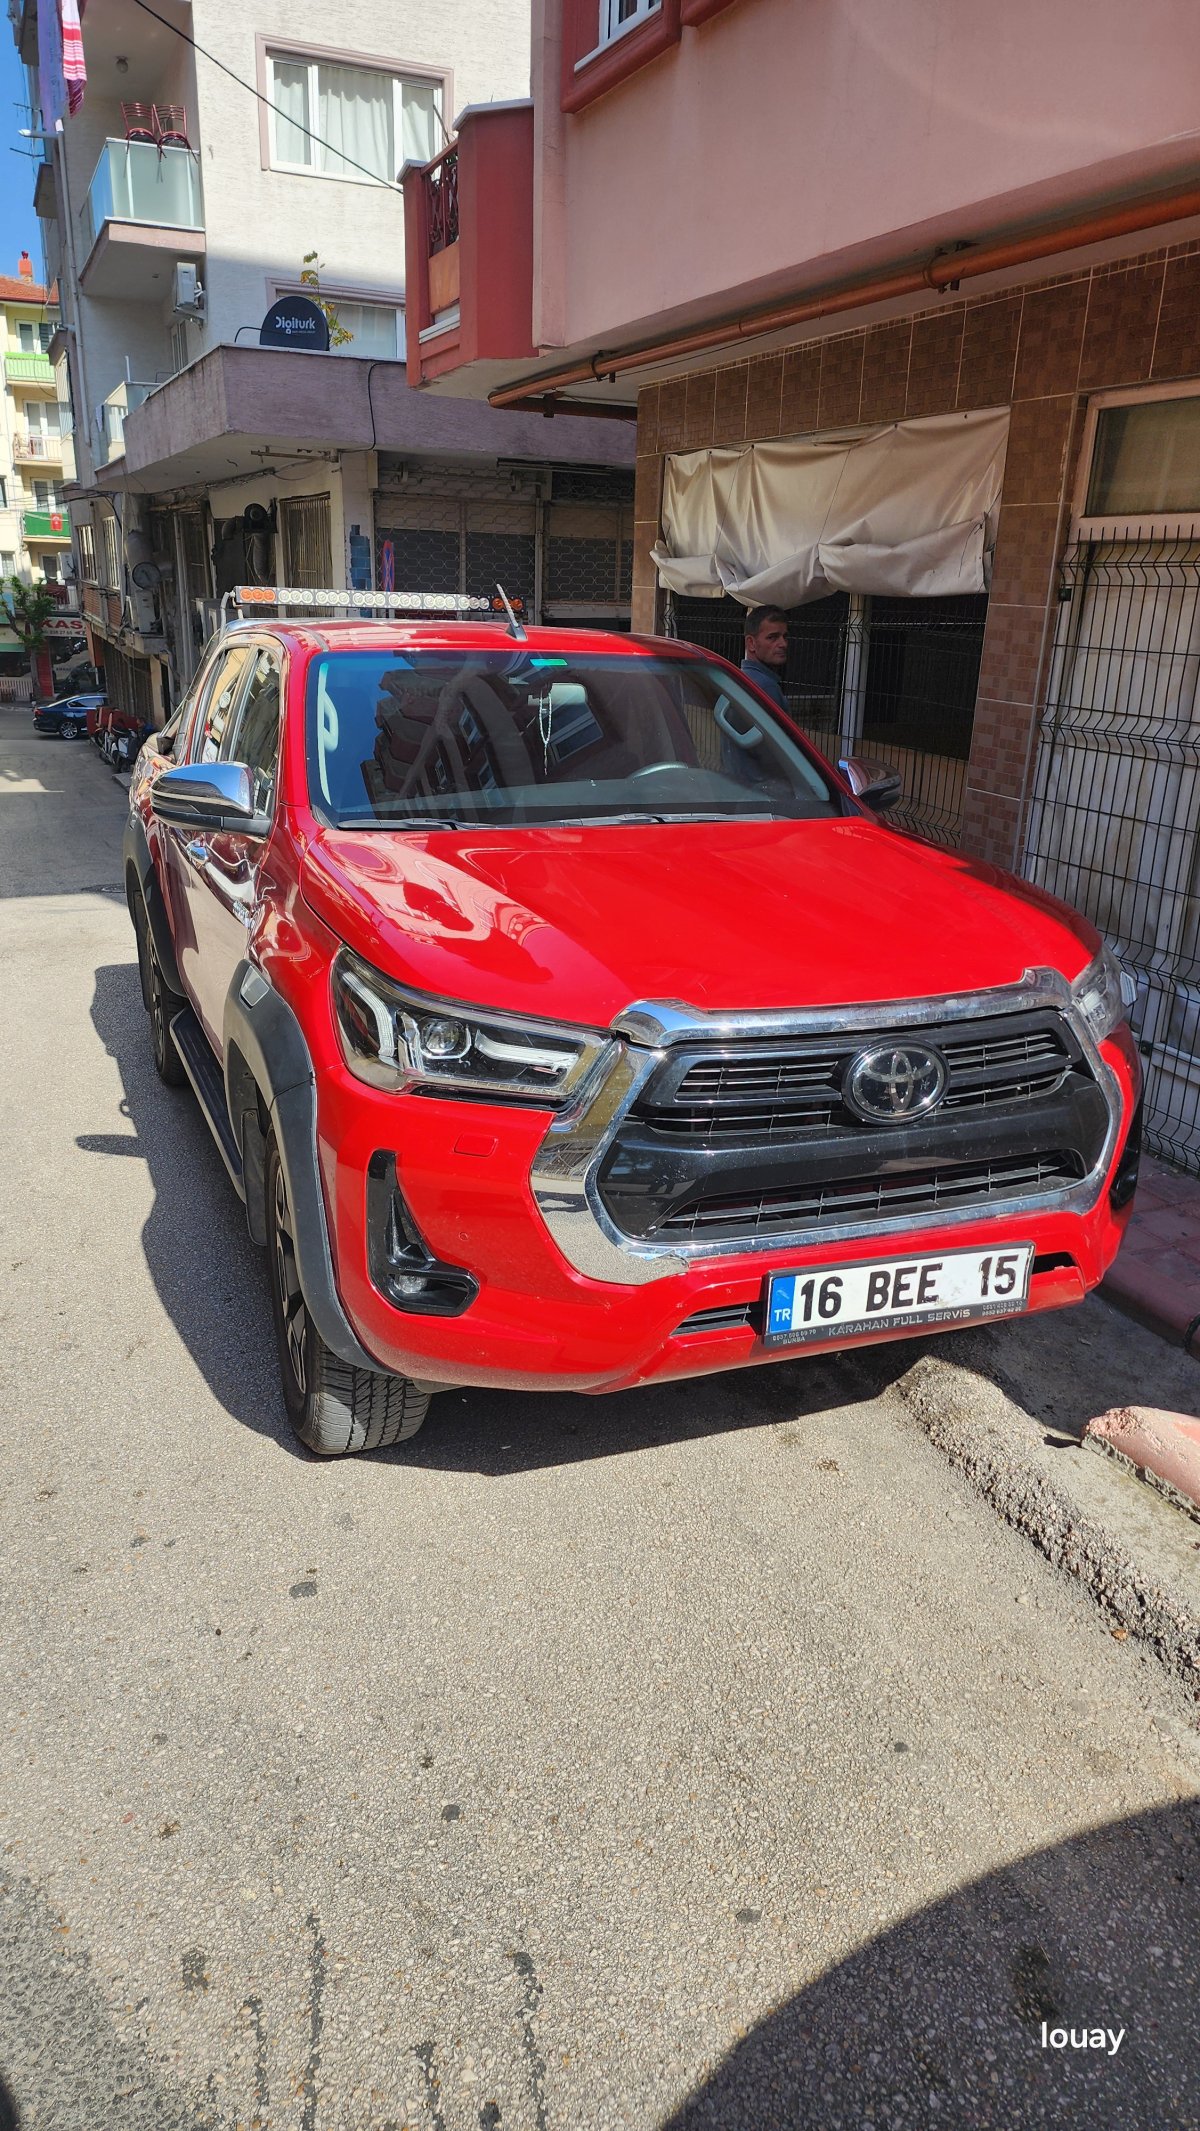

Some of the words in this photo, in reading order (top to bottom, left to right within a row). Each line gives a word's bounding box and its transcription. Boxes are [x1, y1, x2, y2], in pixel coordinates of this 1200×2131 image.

[773, 1308, 791, 1322] TR
[800, 1276, 844, 1322] 16
[865, 1262, 943, 1313] BEE
[978, 1255, 1019, 1298] 15
[828, 1318, 889, 1336] KARAHAN
[892, 1314, 923, 1328] FULL
